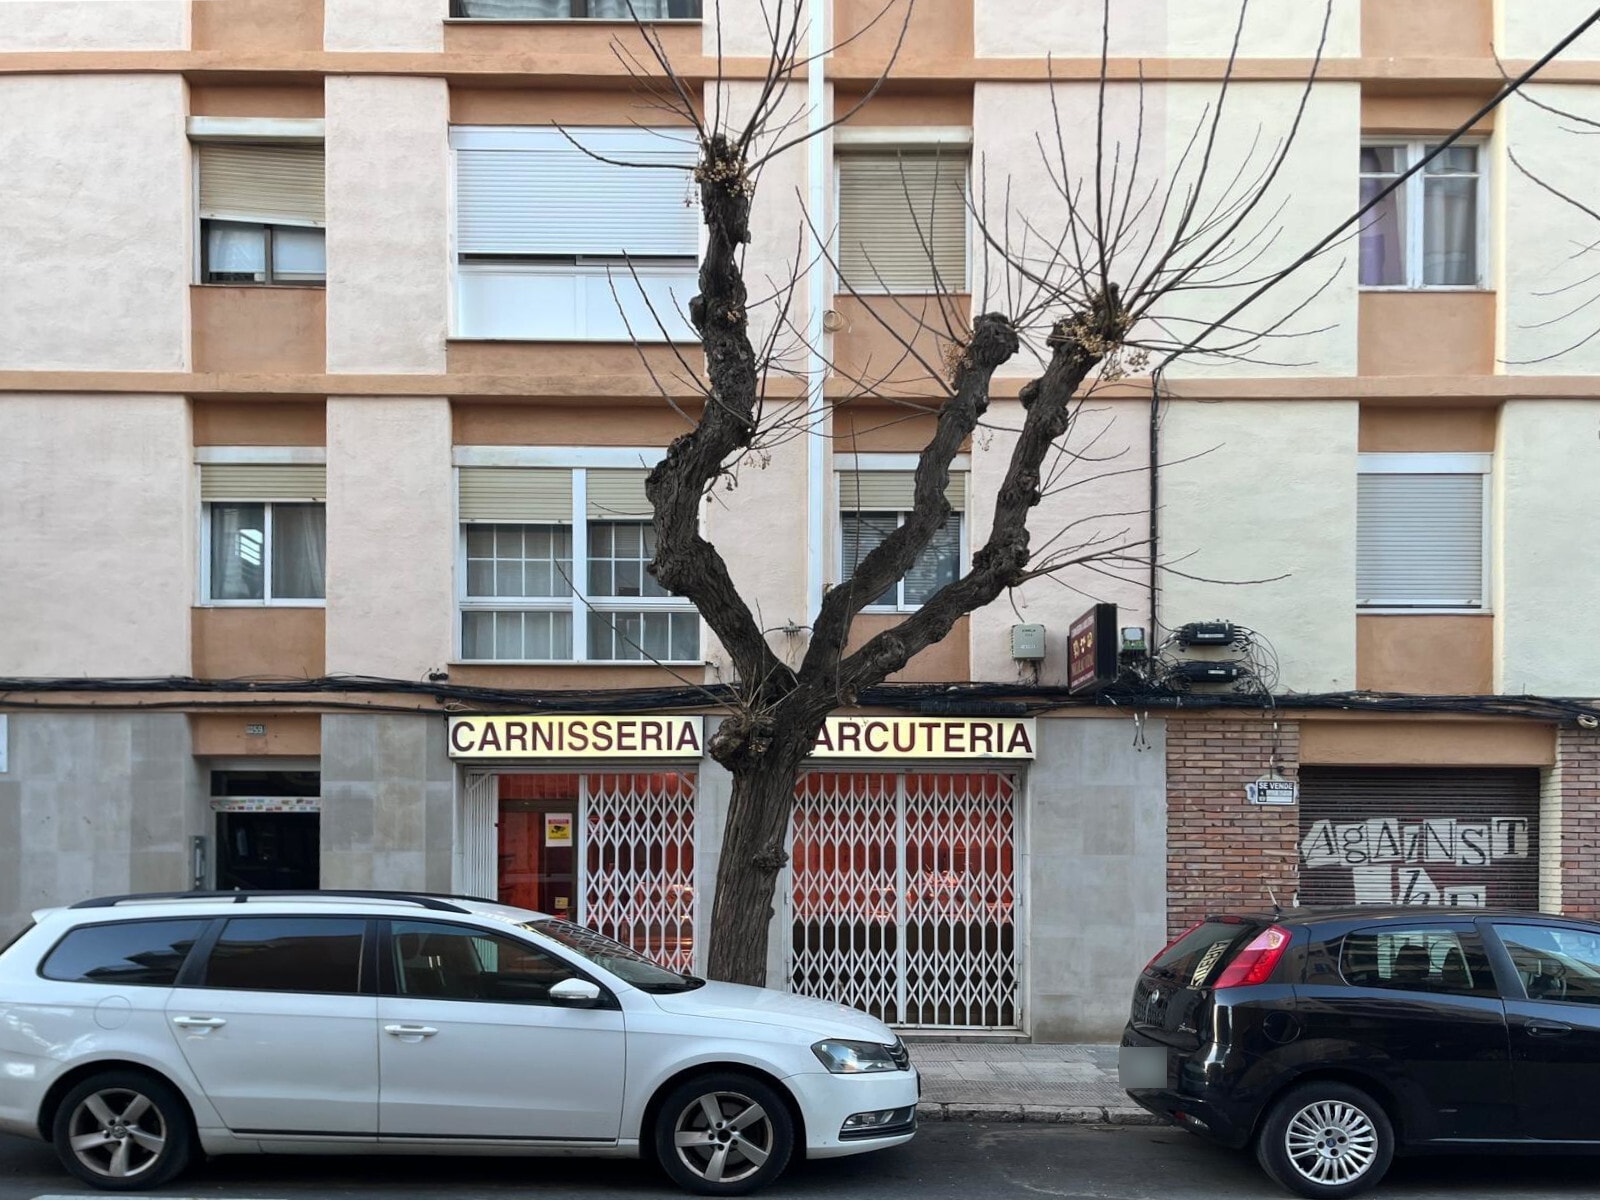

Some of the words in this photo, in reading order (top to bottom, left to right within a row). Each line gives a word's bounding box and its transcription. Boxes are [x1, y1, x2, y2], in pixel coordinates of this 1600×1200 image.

[450, 720, 700, 752] CARNISSERIA
[813, 721, 1033, 753] ARCUTERIA
[1259, 782, 1269, 790] SE
[1269, 782, 1294, 790] VENDE
